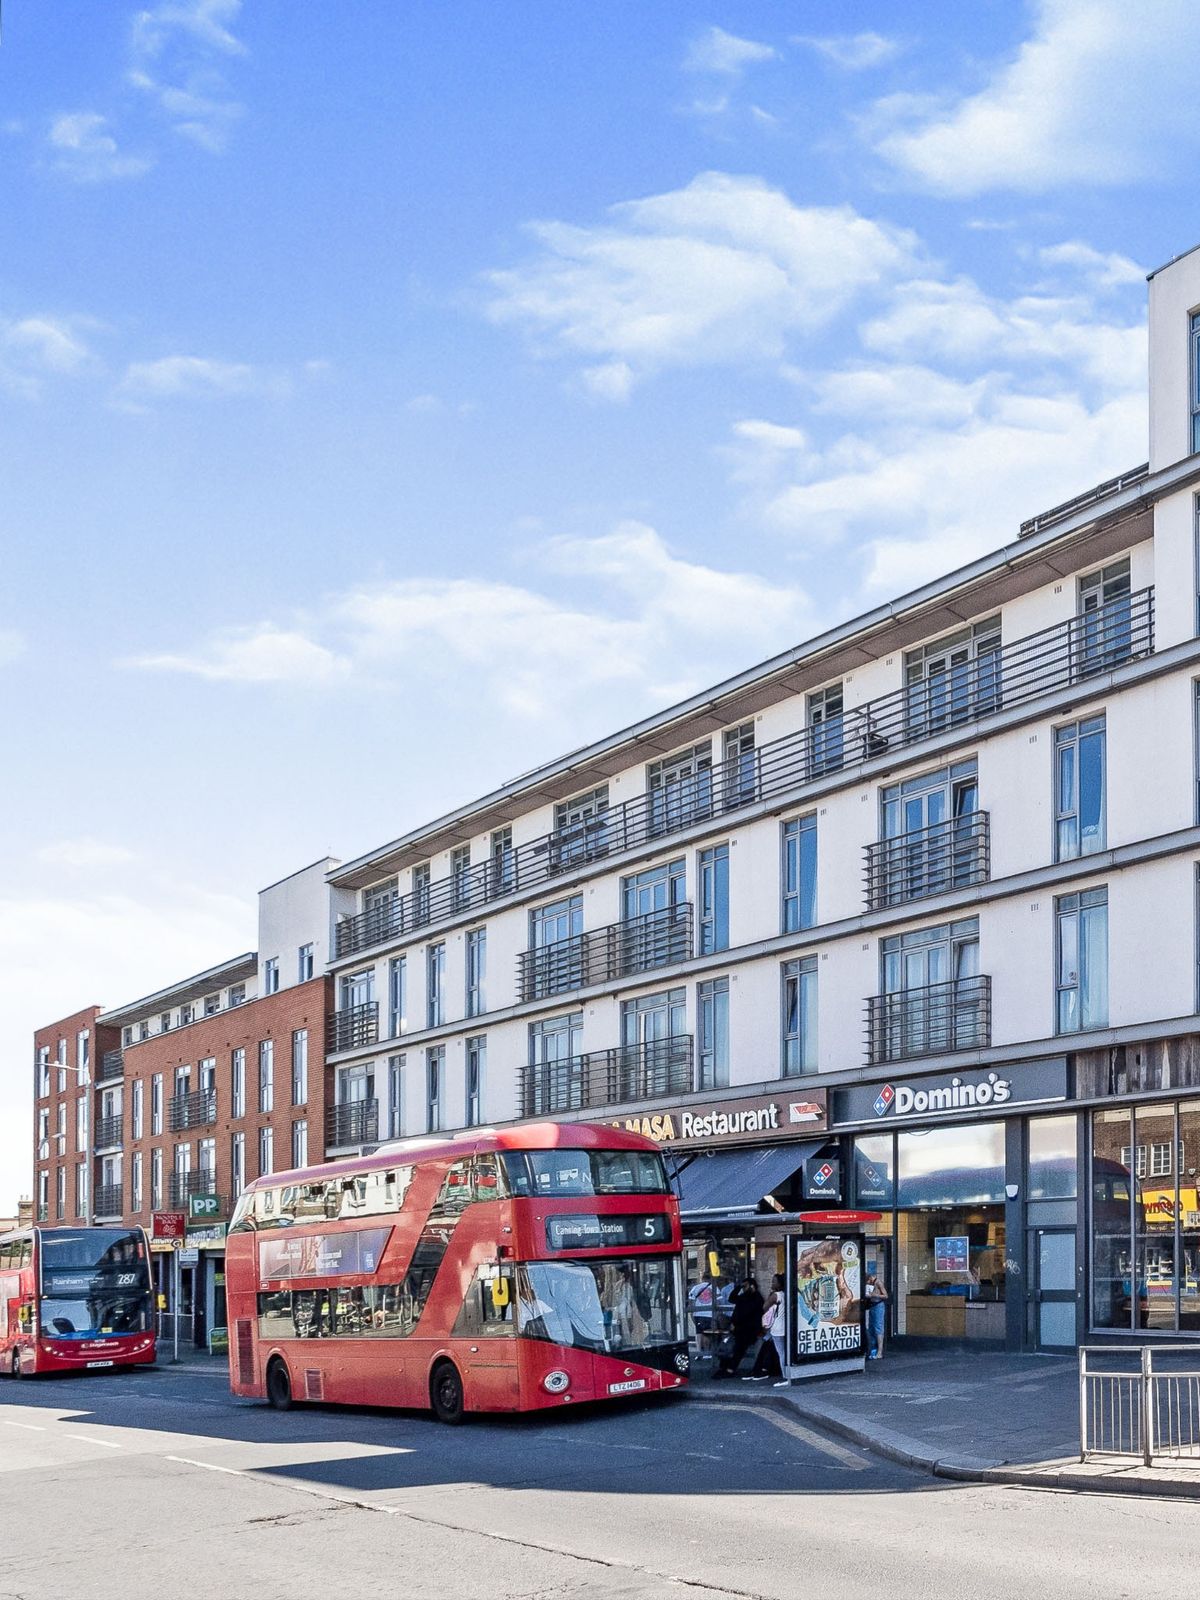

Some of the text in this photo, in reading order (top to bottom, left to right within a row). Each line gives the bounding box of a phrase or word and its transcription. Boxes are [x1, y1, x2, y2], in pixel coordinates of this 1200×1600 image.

[895, 1072, 1011, 1114] Domino's
[681, 1103, 779, 1139] Restaurant
[555, 1224, 582, 1236] Canning
[600, 1222, 624, 1233] Station
[644, 1218, 655, 1237] 5
[118, 1274, 135, 1285] 287
[798, 1325, 860, 1342] GET A TASTE
[798, 1337, 860, 1353] OF BRIXTON
